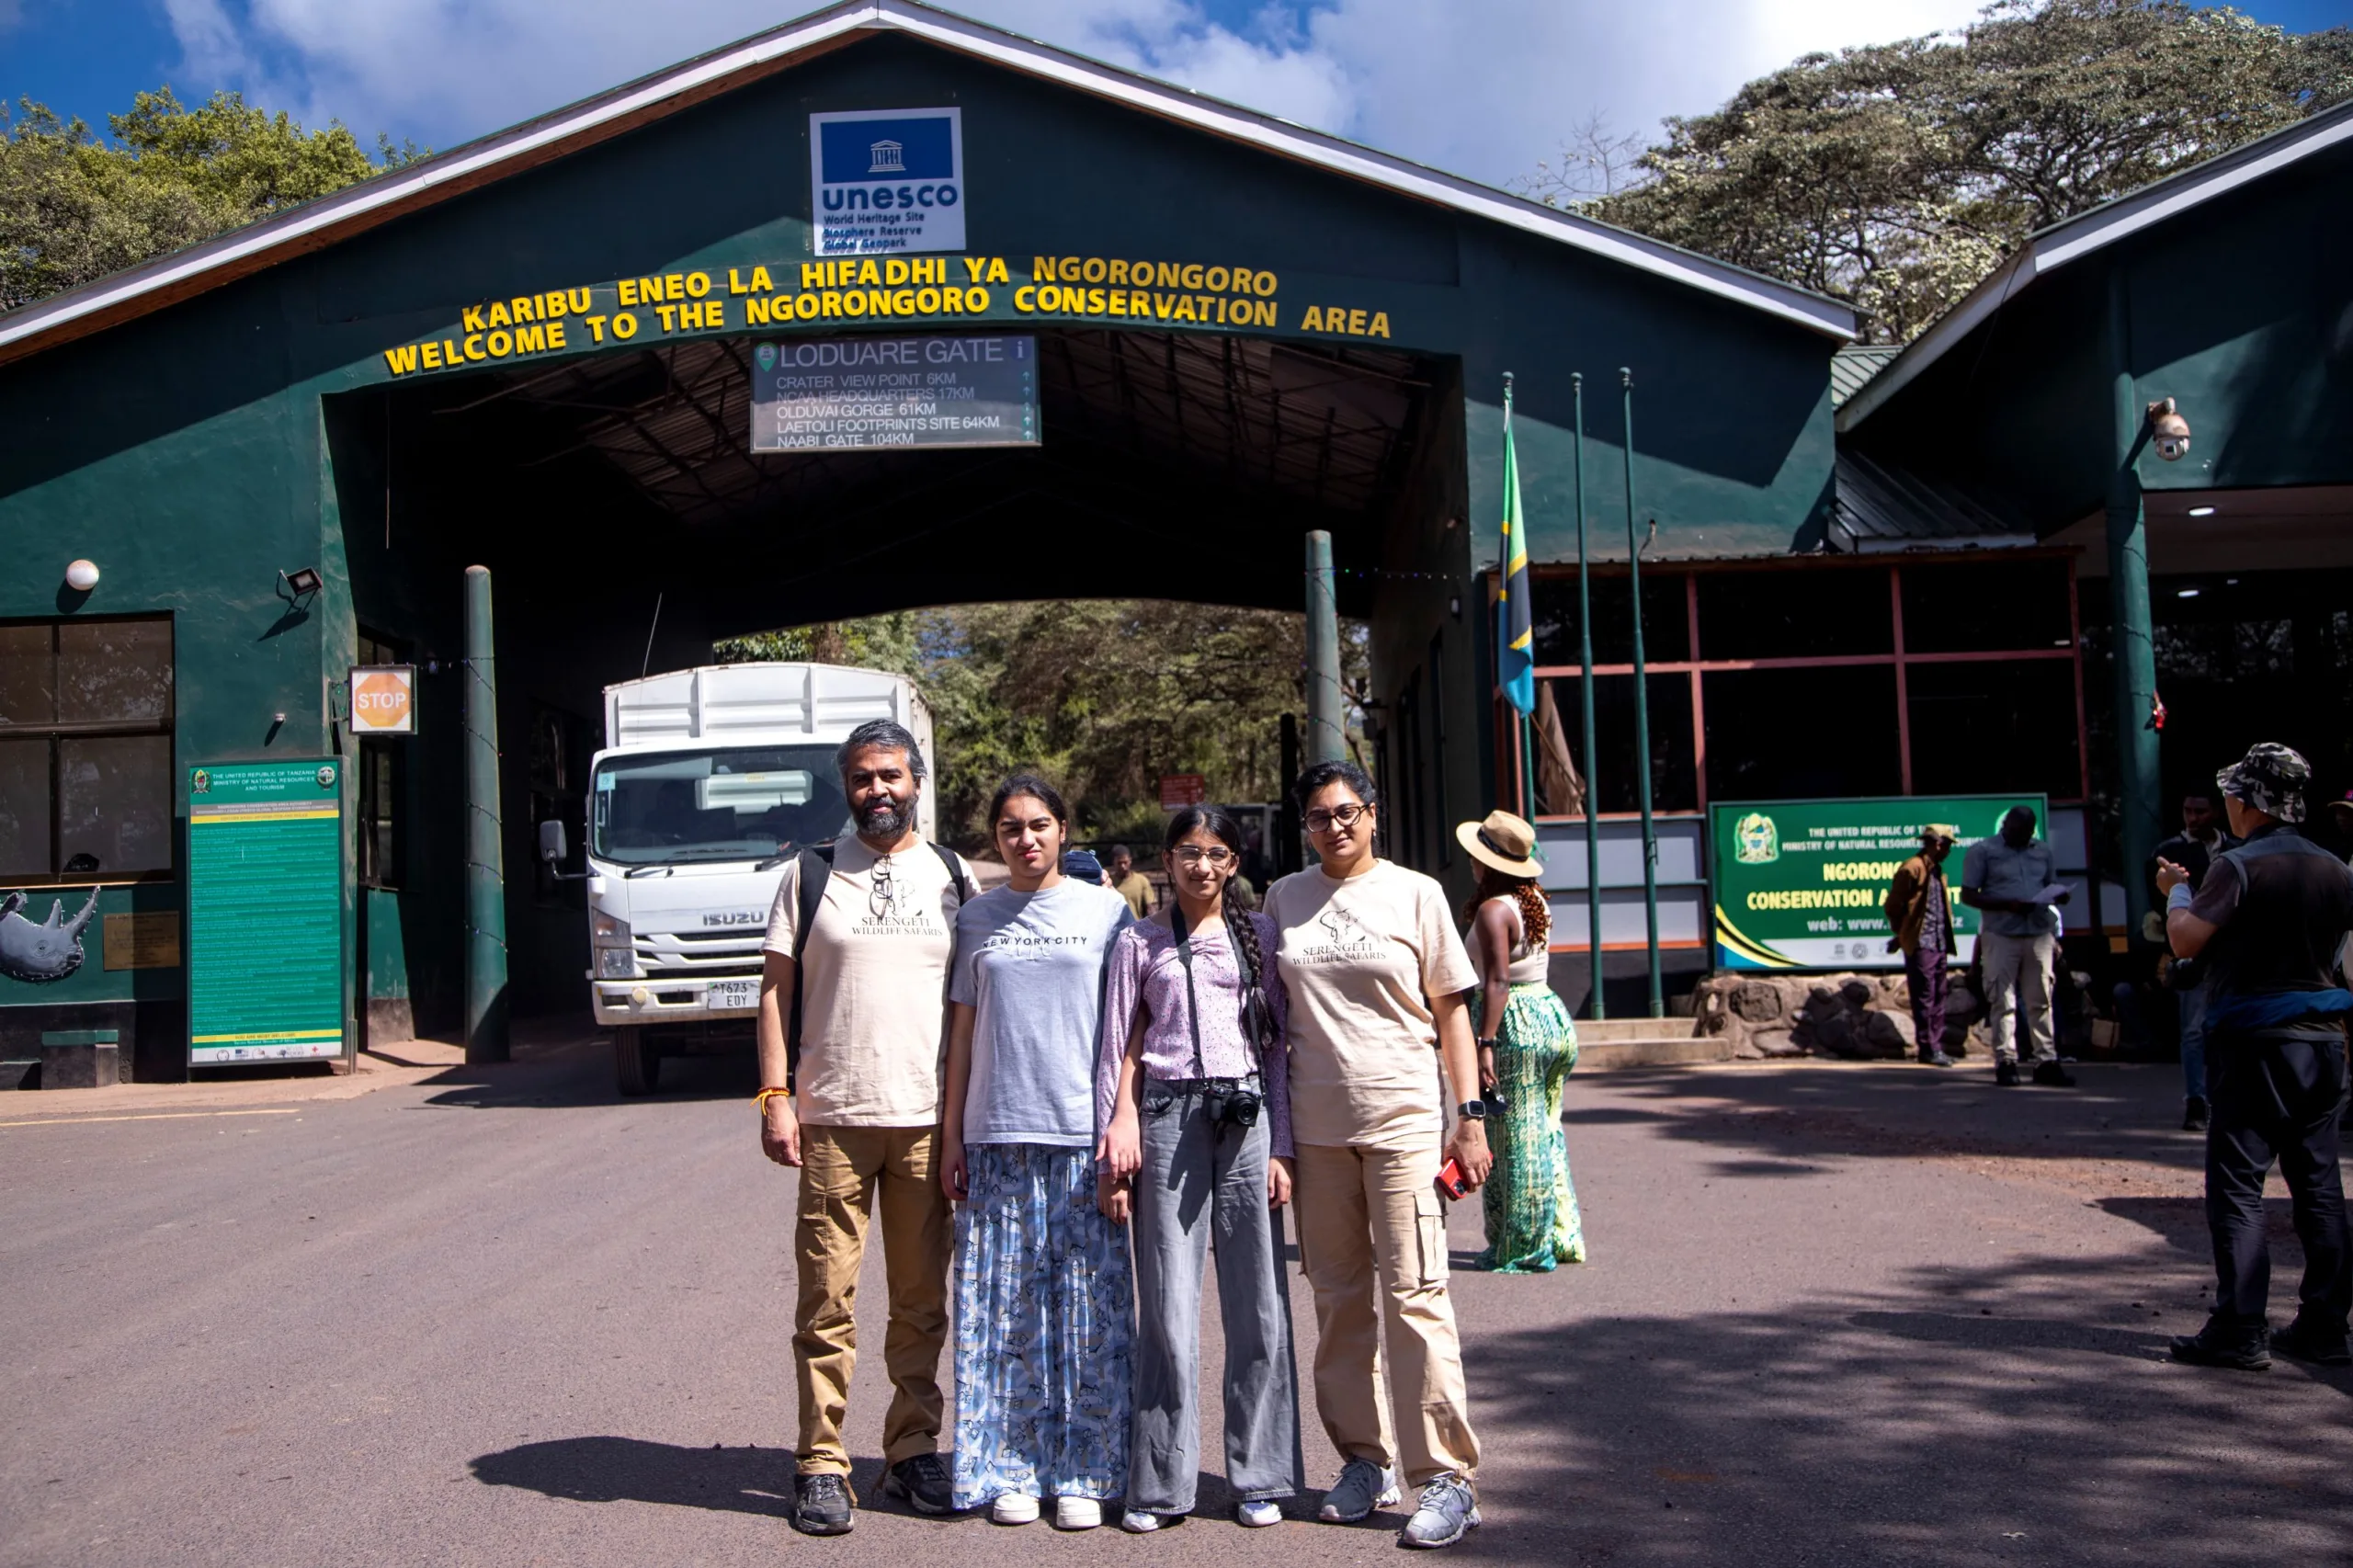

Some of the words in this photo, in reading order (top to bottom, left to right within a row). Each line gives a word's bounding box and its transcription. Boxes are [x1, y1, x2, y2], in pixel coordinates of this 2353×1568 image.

[823, 185, 958, 210] unesco
[824, 213, 854, 224] World
[858, 213, 901, 225] Heritage
[905, 211, 925, 222] Site
[824, 227, 875, 238] Biosphere
[880, 226, 922, 236] Reserve
[824, 239, 857, 250] Global
[860, 238, 906, 250] Geopark
[462, 287, 591, 332] KARIBU
[618, 272, 710, 305] ENEO
[729, 266, 772, 293] LA
[801, 258, 946, 288] HIFADHI
[964, 257, 1008, 282] YA
[1034, 256, 1277, 296] NGORONGORO
[384, 322, 566, 373] WELCOME
[585, 312, 638, 341] TO
[655, 301, 723, 331] THE
[746, 287, 989, 324] NGORONGORO
[1015, 286, 1277, 326] CONSERVATION
[1302, 306, 1389, 337] AREA
[781, 341, 918, 368] LODUARE
[925, 338, 1003, 364] GATE
[777, 376, 834, 389] CRATER
[840, 374, 876, 387] VIEW
[879, 373, 921, 386] POINT
[926, 372, 956, 386] 6KM
[777, 391, 817, 404] NCAA
[819, 388, 935, 403] HEADQUARTERS
[938, 387, 974, 401] 17KM
[777, 404, 838, 418] OLDUVAI
[841, 403, 893, 416] GORGE
[899, 403, 936, 415] 61KM
[778, 420, 834, 434] LAETOLI
[837, 418, 926, 432] FOOTPRINTS
[930, 417, 960, 430] SITE
[962, 416, 999, 428] 64KM
[778, 435, 819, 449] NAABI
[825, 434, 864, 448] GATE
[870, 433, 914, 446] 104KM
[358, 692, 406, 709] STOP
[1809, 827, 1825, 837] THE
[1827, 827, 1859, 837] UNITED
[1860, 826, 1902, 836] REPUBLIC
[1904, 825, 1915, 835] OF
[1782, 841, 1823, 851] MINISTRY
[1824, 840, 1836, 850] OF
[1838, 839, 1877, 850] NATURAL
[1747, 889, 1873, 910] CONSERVATION
[703, 911, 764, 926] ISUZU
[861, 916, 929, 926] SERENGETI
[1807, 916, 1843, 932] web:
[852, 926, 901, 935] WILDLIFE
[904, 927, 943, 937] SAFARIS
[983, 937, 1010, 949] NEW
[1015, 937, 1050, 946] YORK
[1054, 937, 1087, 945] CITY
[1302, 942, 1372, 956] SERENGETI
[1292, 953, 1343, 965] WILDLIFE
[720, 982, 747, 994] T673
